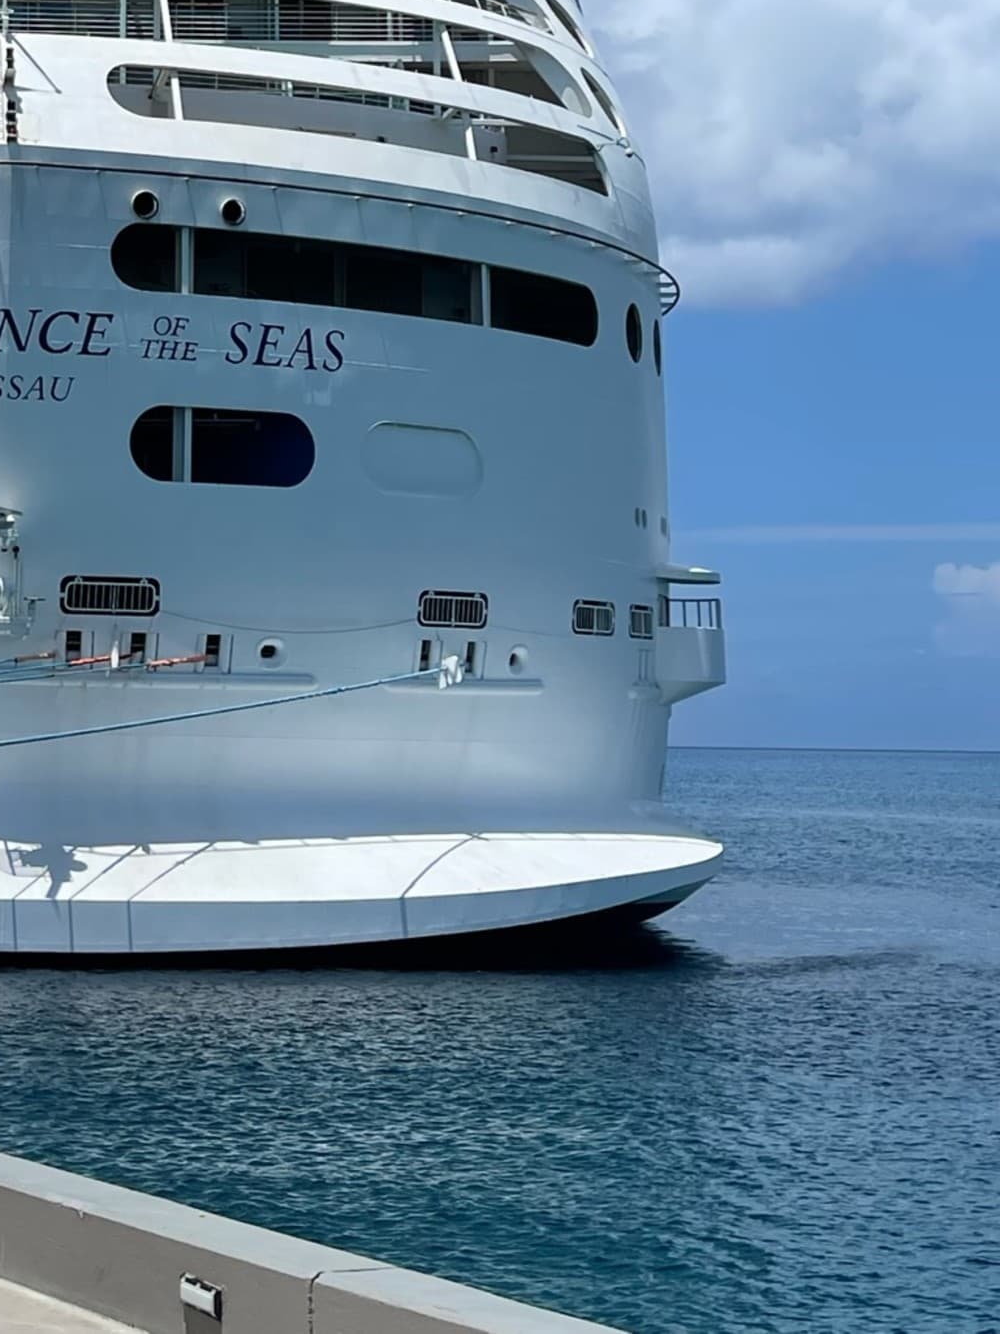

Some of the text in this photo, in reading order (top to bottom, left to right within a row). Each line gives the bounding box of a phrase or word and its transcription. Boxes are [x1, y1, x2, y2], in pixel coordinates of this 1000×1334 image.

[153, 316, 190, 337] OF
[140, 338, 199, 362] THE
[224, 321, 346, 373] SEAS
